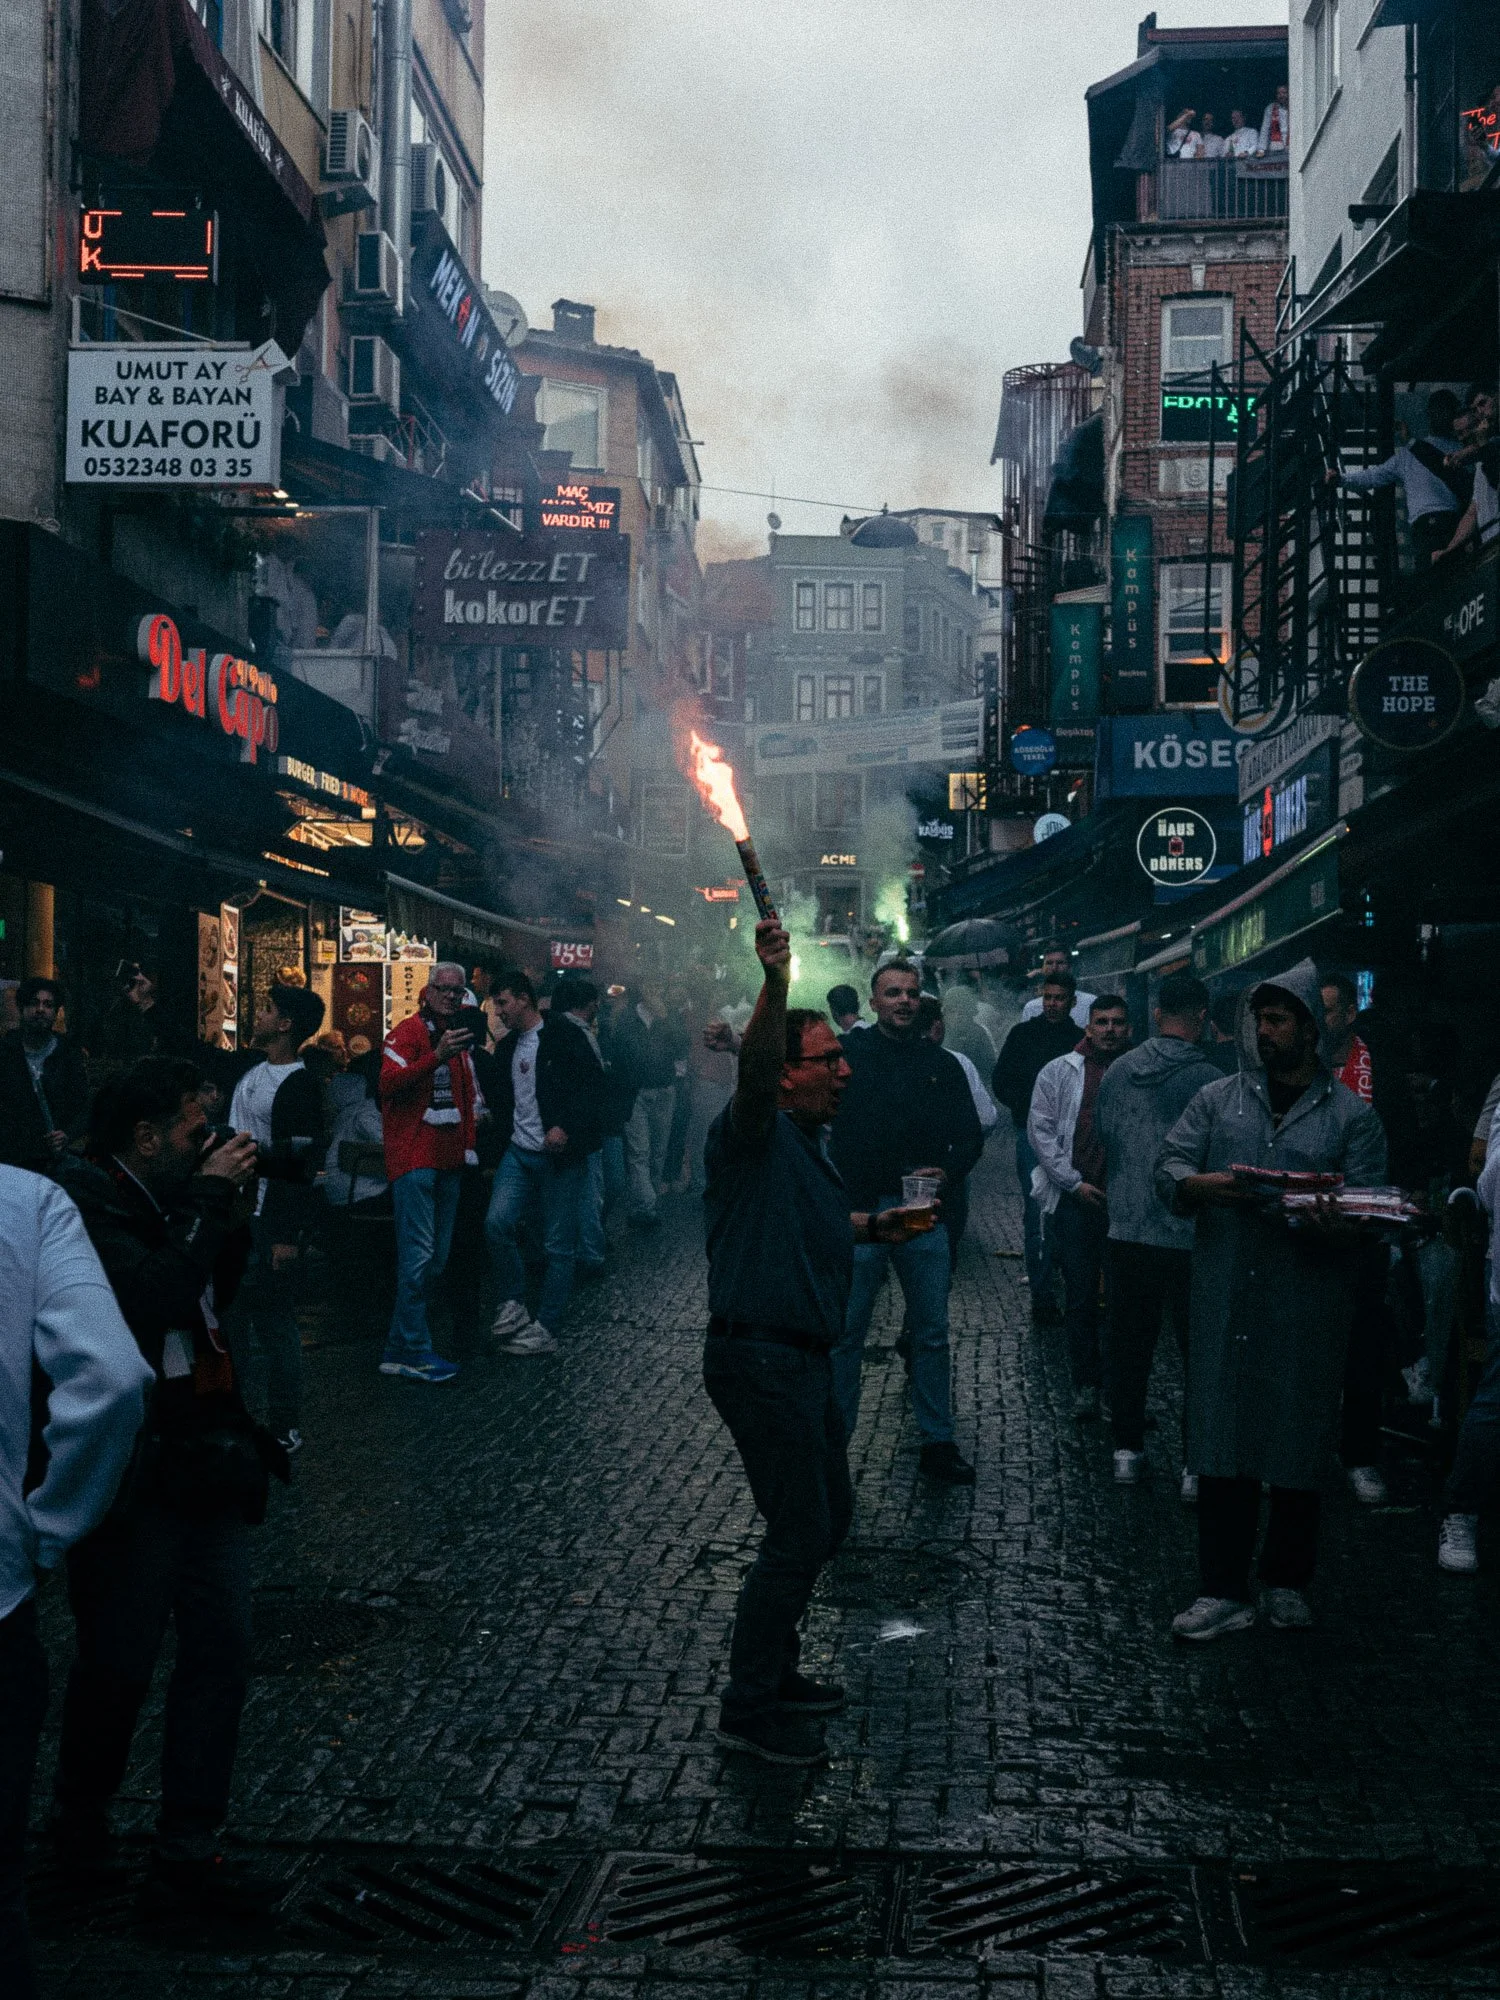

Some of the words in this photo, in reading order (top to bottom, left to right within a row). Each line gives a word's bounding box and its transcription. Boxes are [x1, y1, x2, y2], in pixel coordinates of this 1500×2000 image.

[430, 248, 481, 350] MEKAN
[117, 361, 188, 380] UMUT
[195, 361, 227, 380] AY
[95, 386, 141, 405] BAY
[148, 386, 164, 405] &
[173, 386, 252, 405] BAYAN
[81, 412, 260, 449] KUAFORÜ
[84, 457, 182, 477] 0532348
[190, 457, 217, 477] 03
[225, 457, 252, 477] 35
[557, 485, 589, 501] MAÇ
[443, 589, 595, 626] kokorET
[147, 613, 207, 719] Del
[216, 654, 279, 765] Capo
[1388, 675, 1429, 693] THE
[1382, 696, 1436, 713] HOPE
[820, 854, 857, 865] ACME
